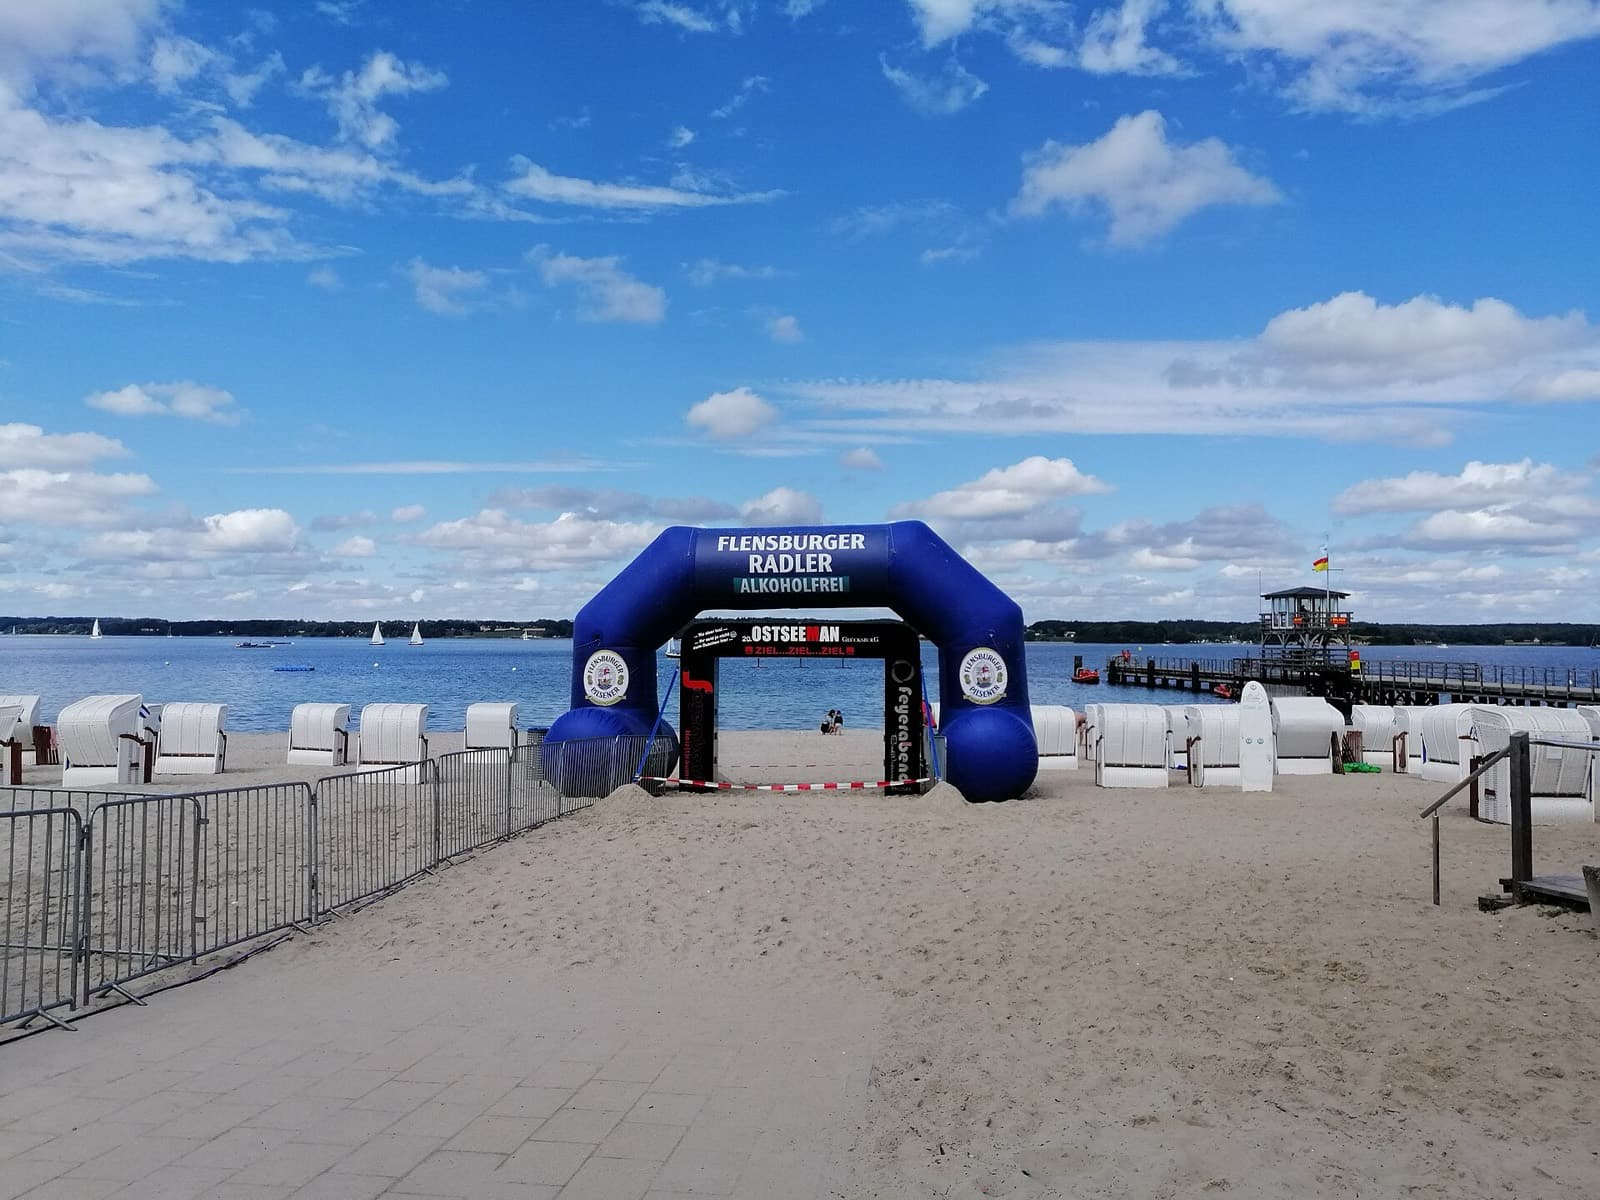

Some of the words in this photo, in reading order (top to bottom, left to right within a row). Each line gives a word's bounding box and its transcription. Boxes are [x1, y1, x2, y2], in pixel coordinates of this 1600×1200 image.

[717, 533, 865, 552] FLENSBURGER
[749, 553, 833, 574] RADLER
[740, 577, 844, 594] ALKOHOLFREI
[752, 625, 840, 642] OSTSEEMAN
[587, 655, 624, 674] FLENSBURGER
[964, 652, 1003, 673] FLENSBURGER
[590, 686, 621, 699] PILSENER
[969, 684, 1001, 698] PILSENER
